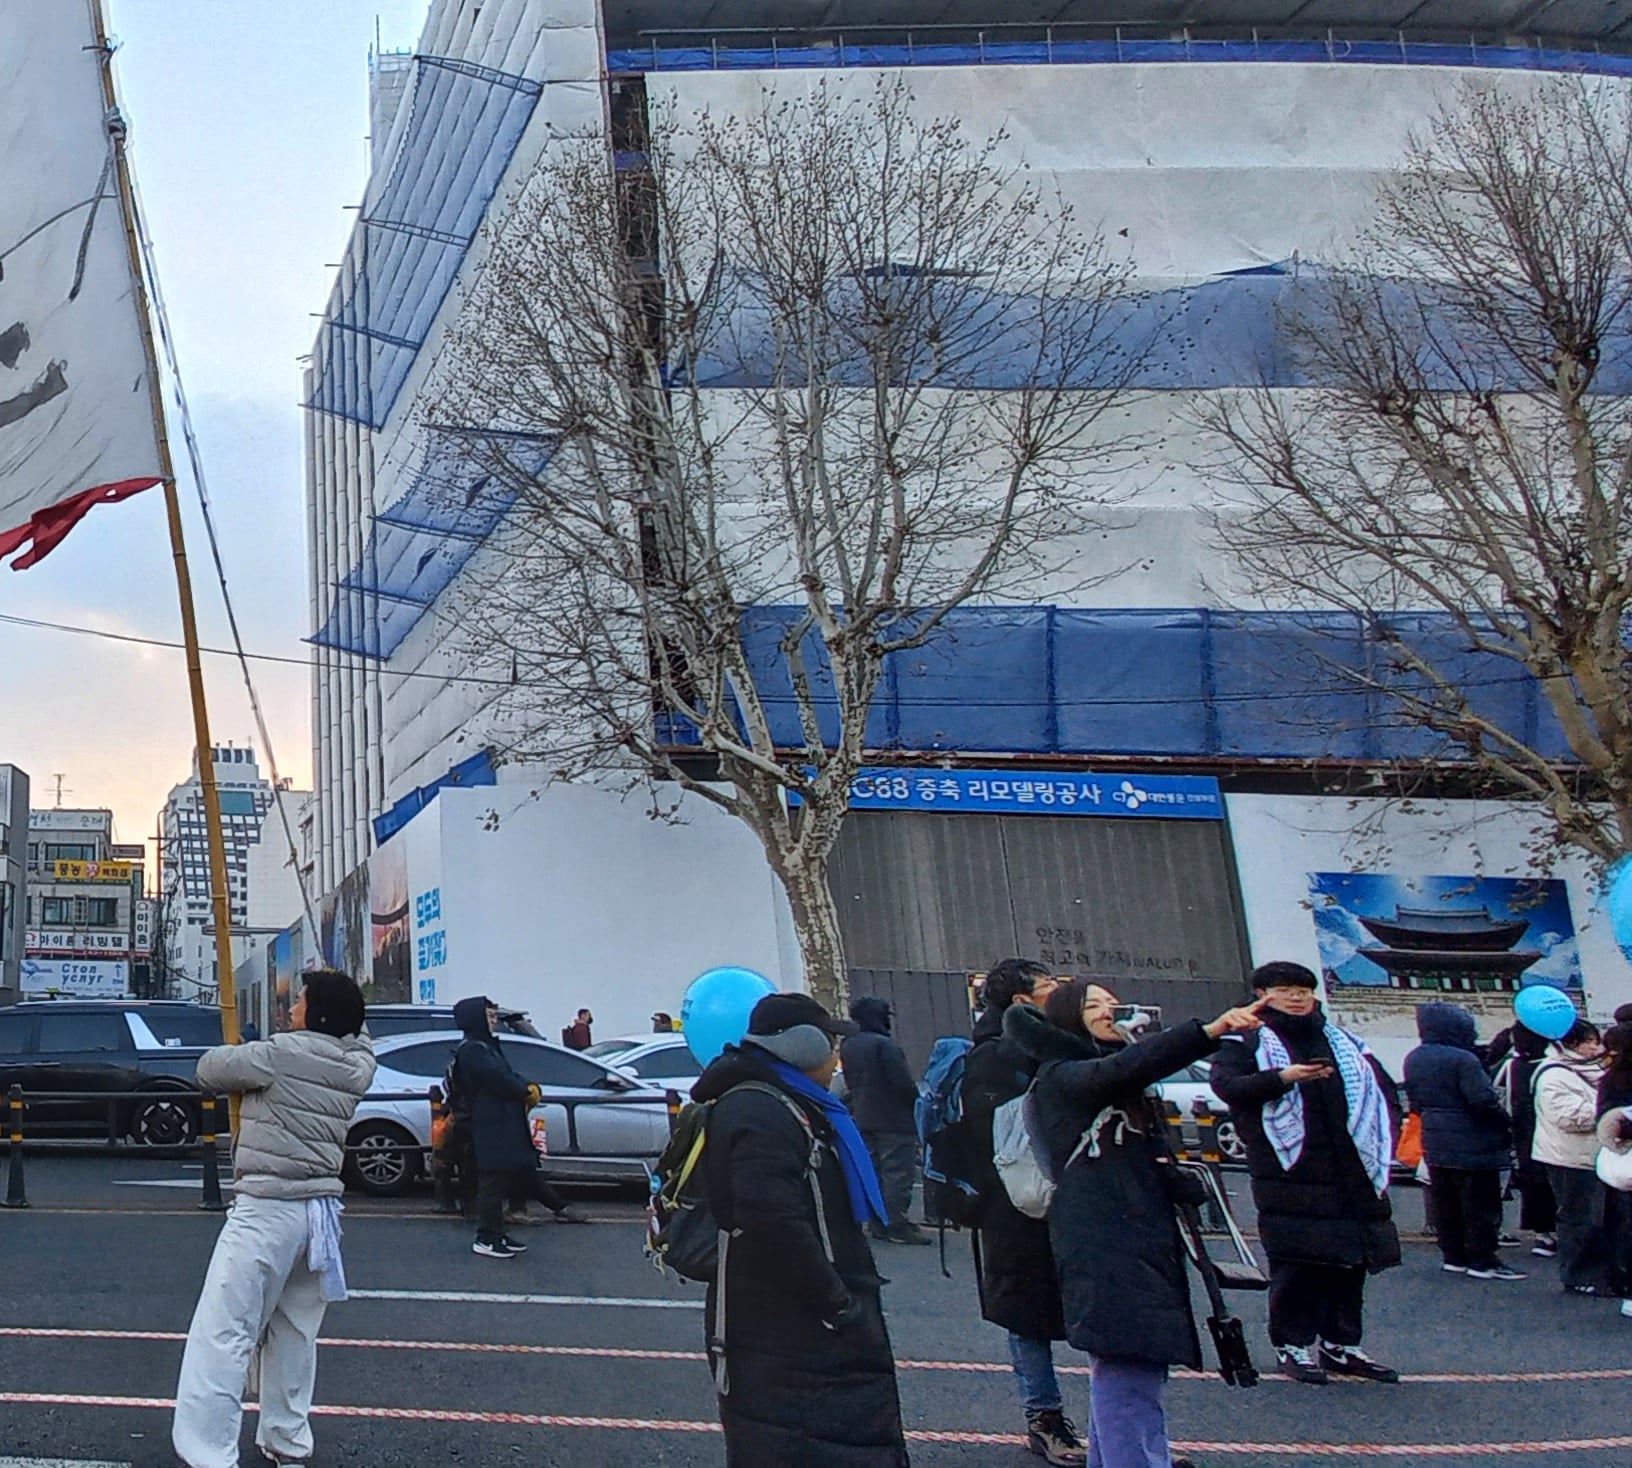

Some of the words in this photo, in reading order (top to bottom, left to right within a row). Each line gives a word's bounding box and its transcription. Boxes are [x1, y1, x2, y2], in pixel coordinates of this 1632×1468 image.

[915, 776, 962, 802] 증축
[967, 779, 1103, 805] 리모델링공사
[61, 963, 98, 974] Стол
[61, 973, 104, 985] услуг
